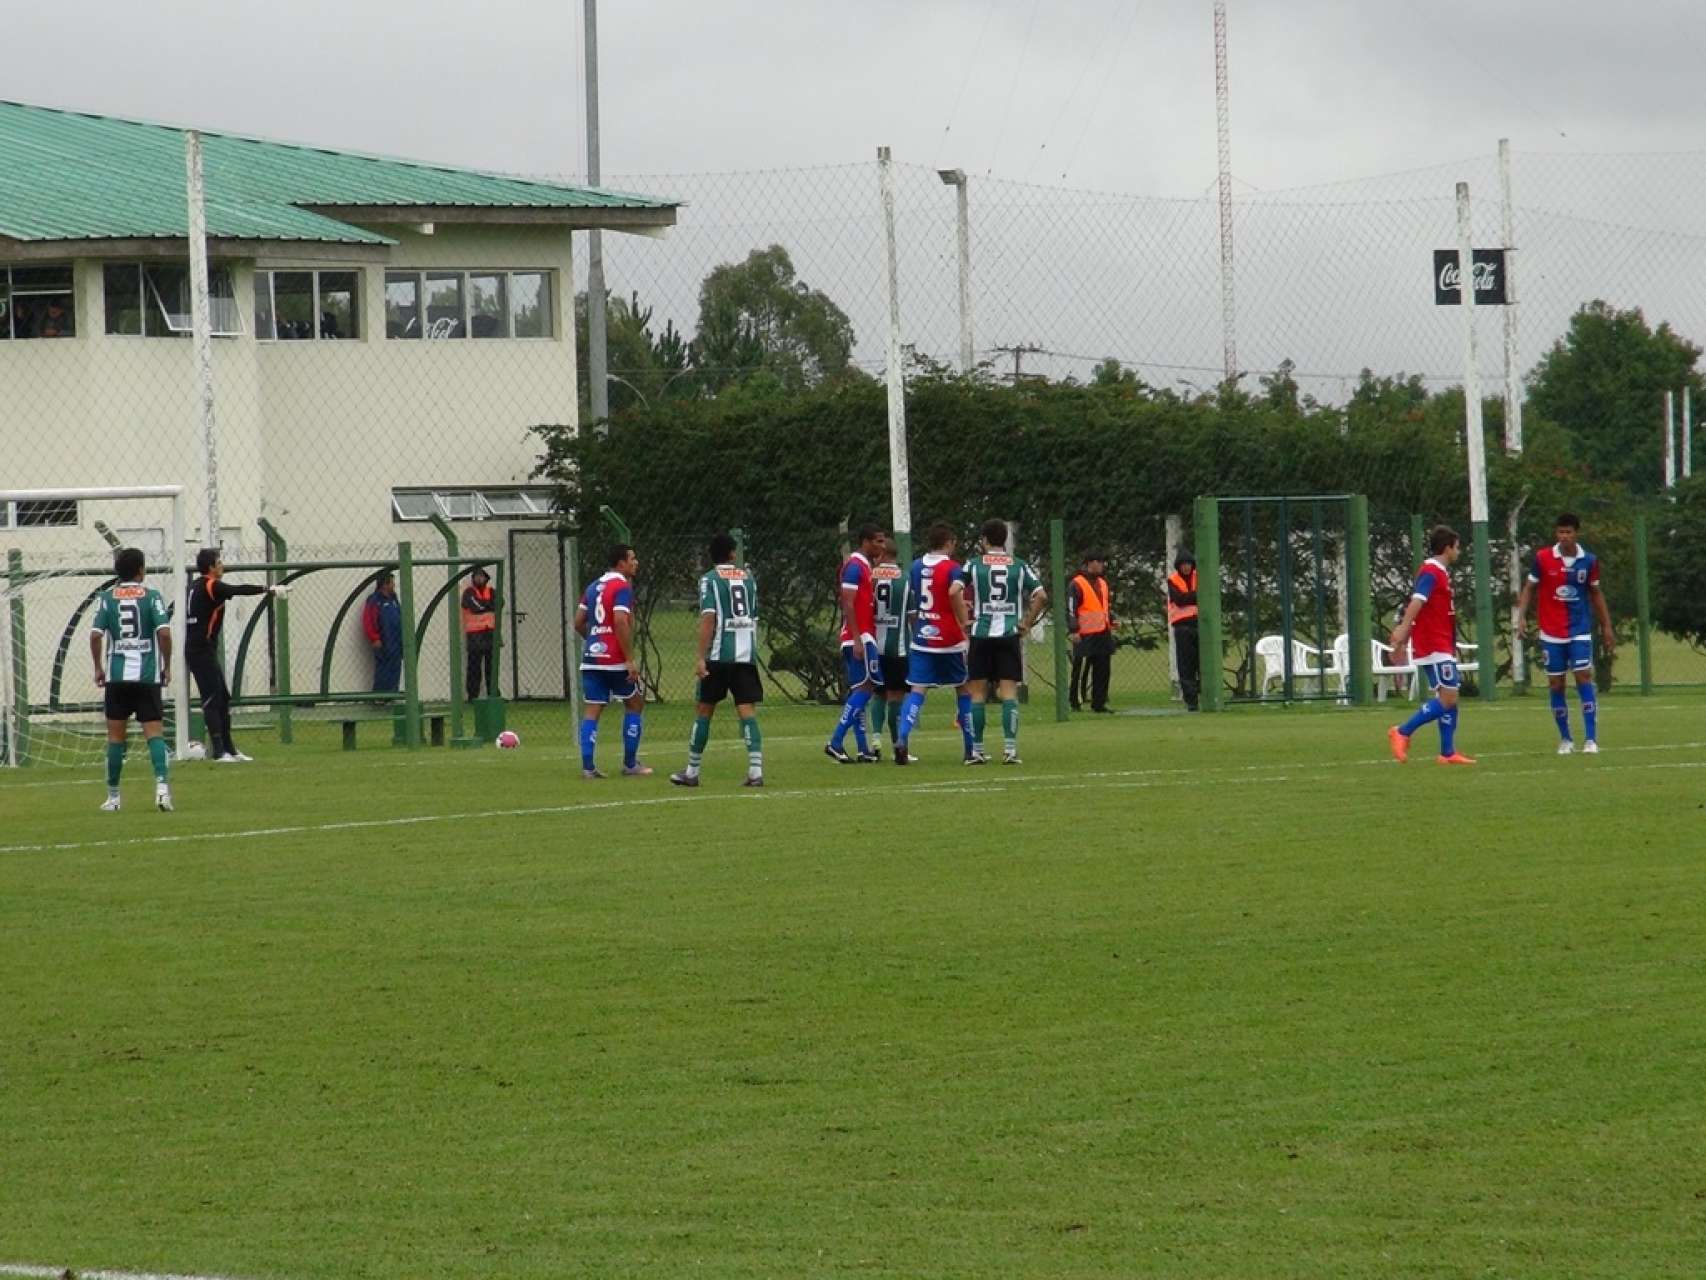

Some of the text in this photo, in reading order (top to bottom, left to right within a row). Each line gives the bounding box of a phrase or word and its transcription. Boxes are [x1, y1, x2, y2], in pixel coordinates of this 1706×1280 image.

[731, 584, 750, 617] 8
[876, 582, 892, 609] 9
[920, 578, 934, 610] 5
[990, 569, 1008, 602] 5
[118, 603, 140, 639] 3
[594, 592, 606, 624] 6
